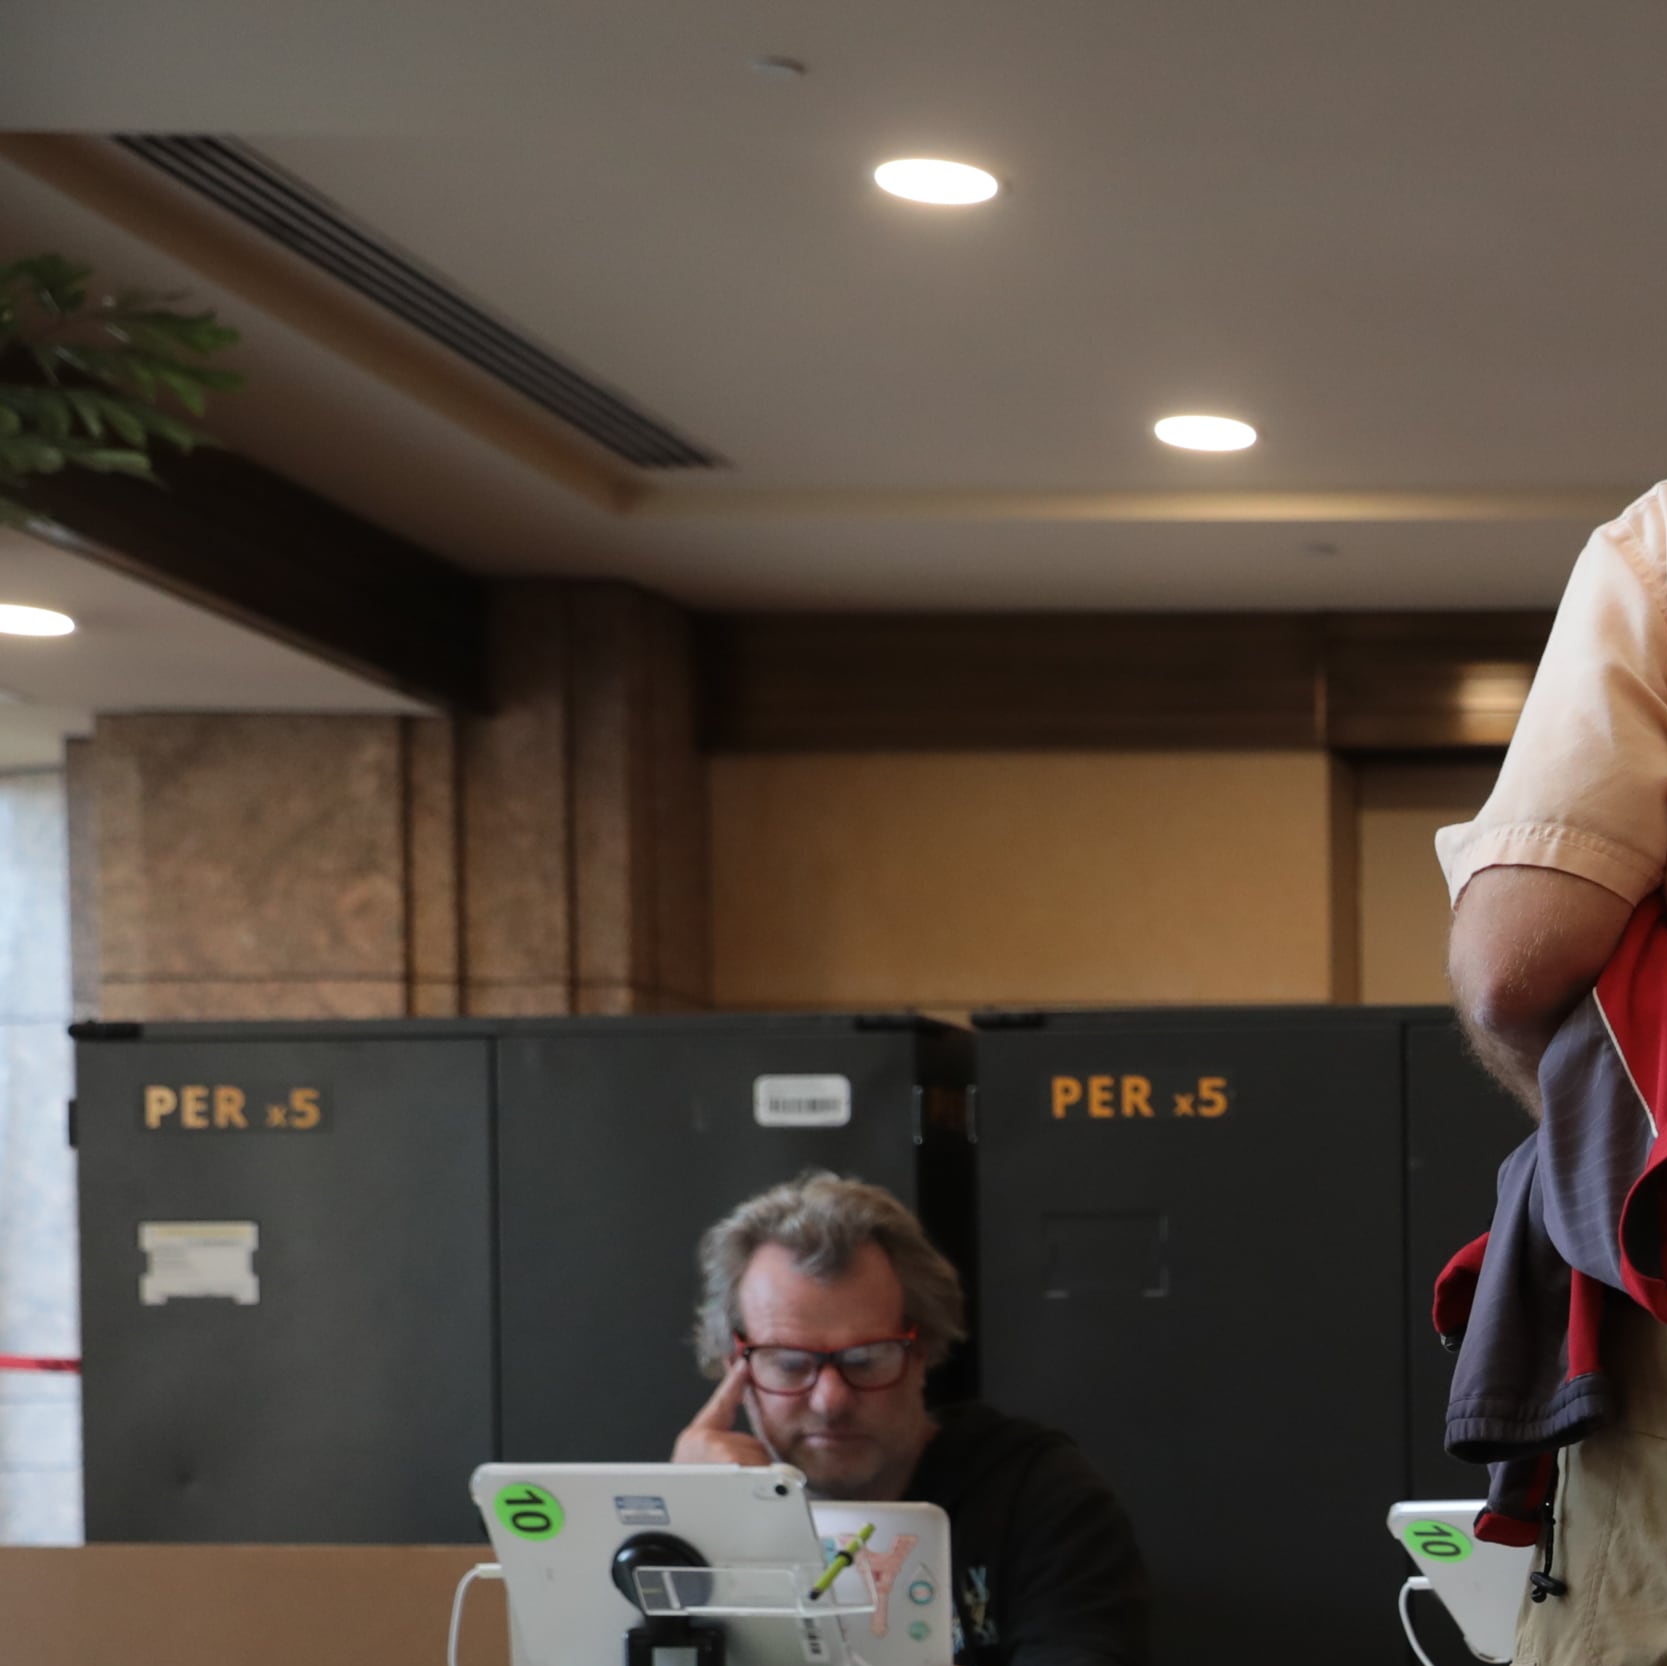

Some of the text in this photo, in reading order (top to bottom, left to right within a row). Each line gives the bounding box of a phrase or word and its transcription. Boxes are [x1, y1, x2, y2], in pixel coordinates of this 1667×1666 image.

[145, 1086, 321, 1129] PER x5
[1052, 1075, 1228, 1118] PER x5
[505, 1489, 551, 1533] 10
[1413, 1524, 1461, 1556] 10
